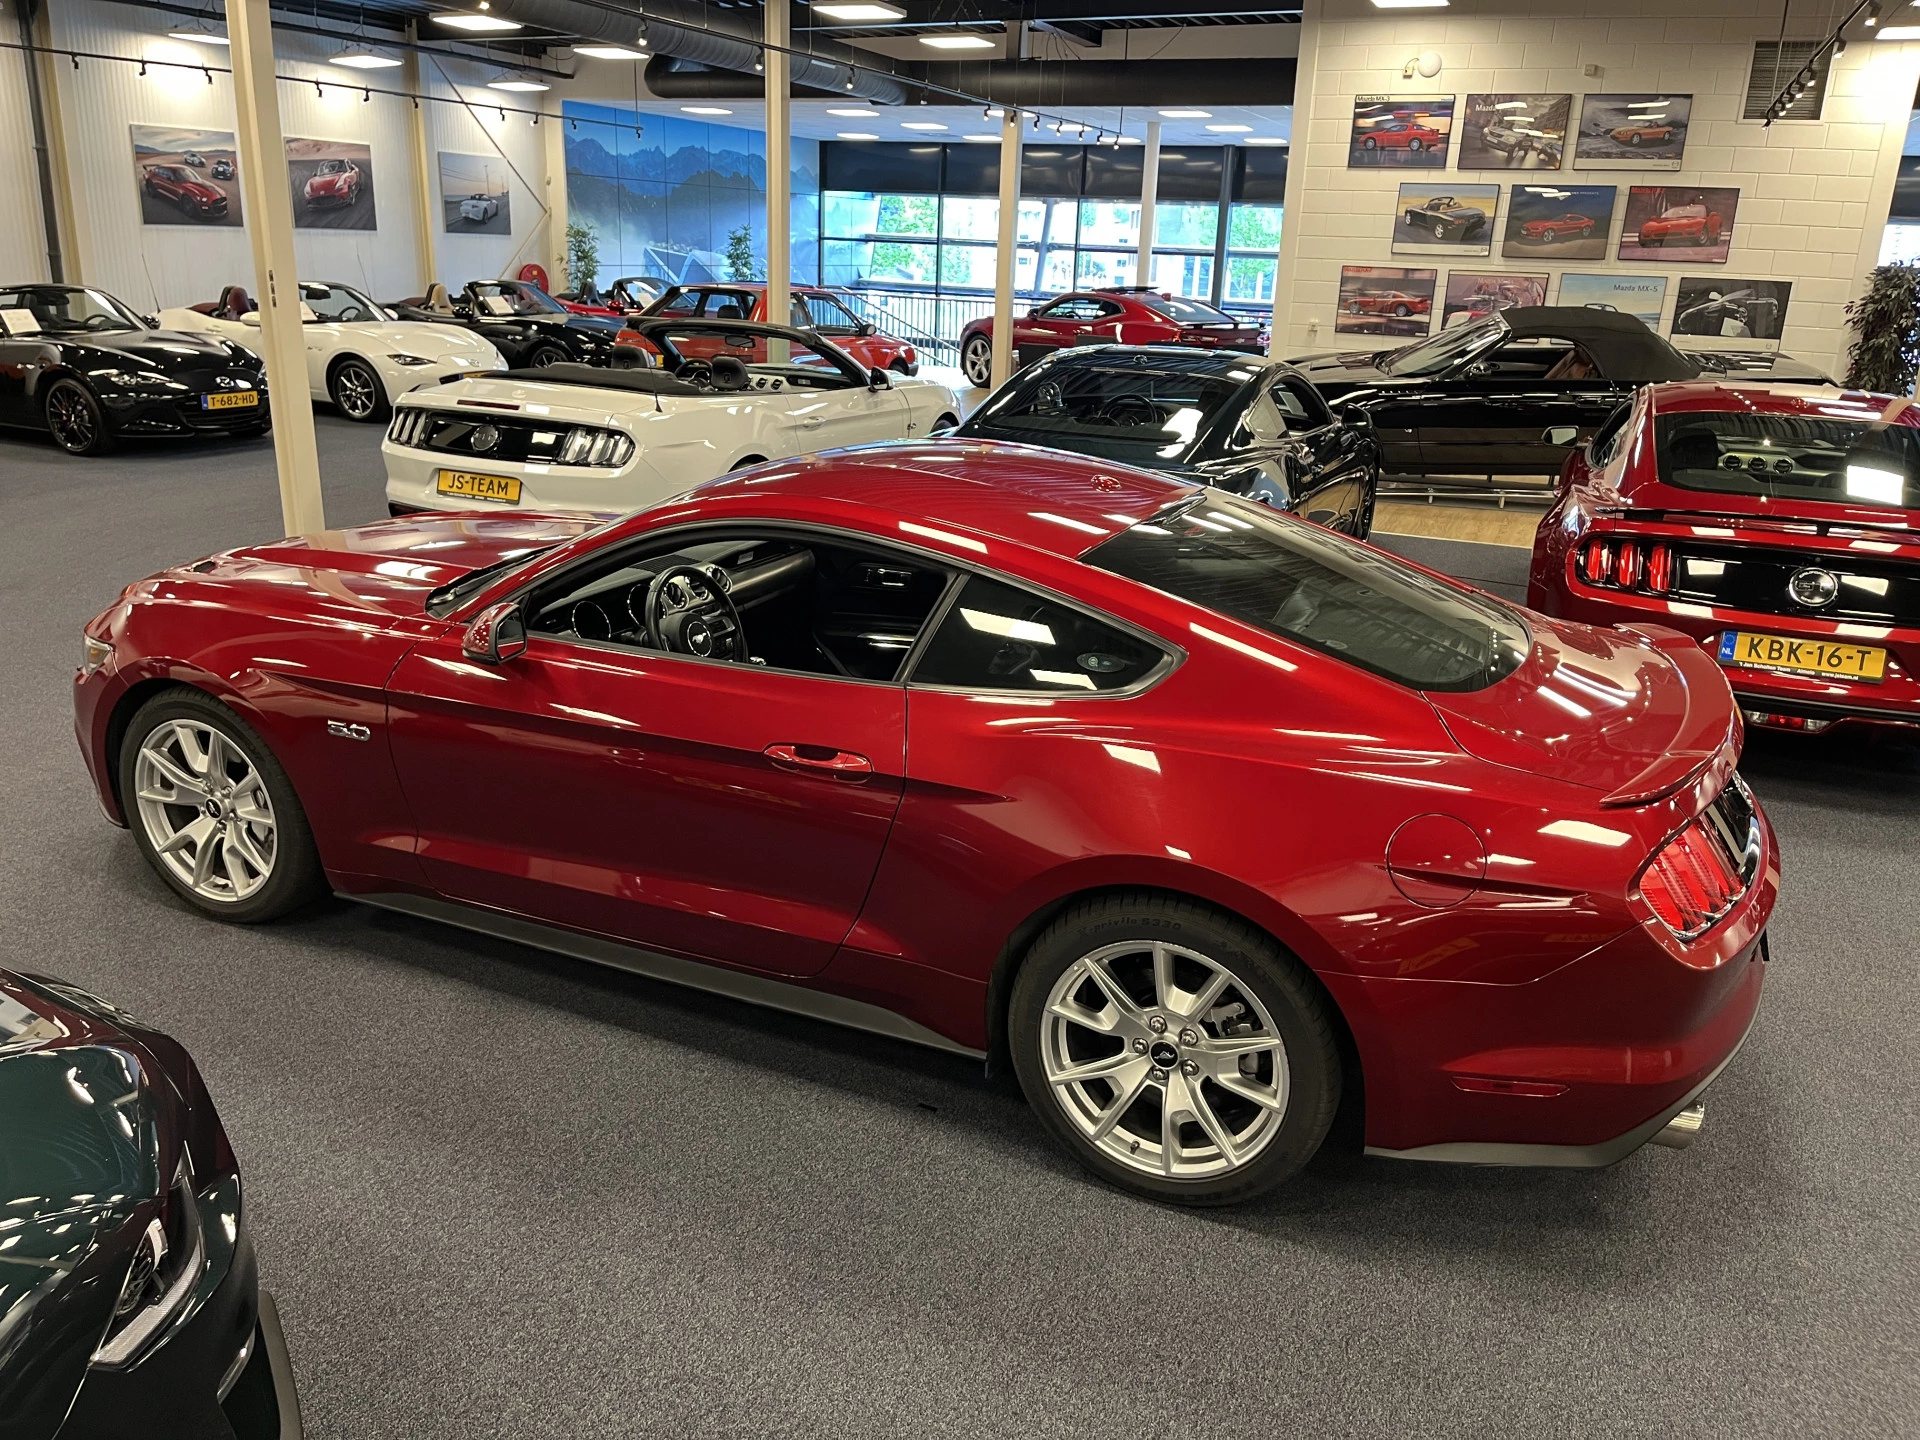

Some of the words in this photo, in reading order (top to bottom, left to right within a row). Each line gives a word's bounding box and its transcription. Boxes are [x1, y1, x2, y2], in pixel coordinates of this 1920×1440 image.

[1613, 284, 1636, 292] Mazda
[1637, 285, 1658, 293] MX-5
[210, 394, 255, 407] T-682-HD
[448, 474, 509, 496] JS-TEAM
[1721, 647, 1733, 655] NL
[1748, 637, 1872, 671] KBK-16-T
[327, 719, 371, 741] 5.0
